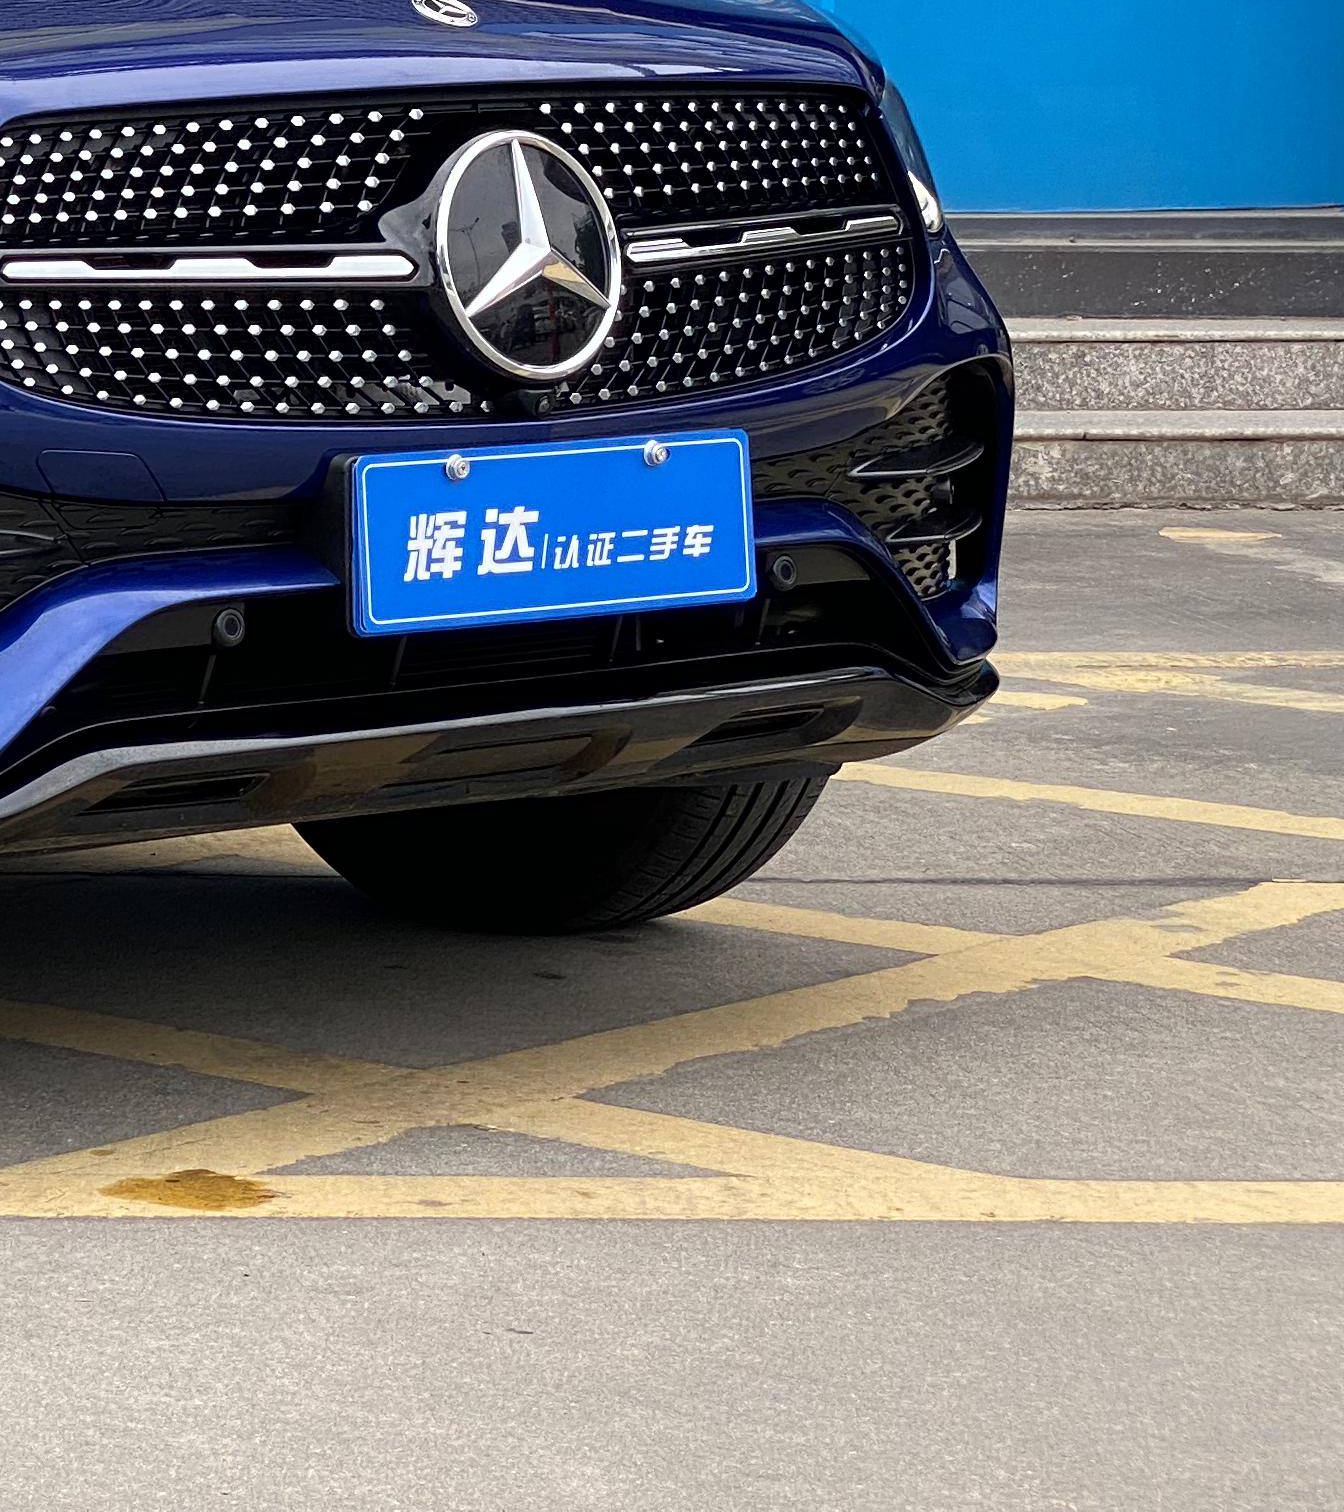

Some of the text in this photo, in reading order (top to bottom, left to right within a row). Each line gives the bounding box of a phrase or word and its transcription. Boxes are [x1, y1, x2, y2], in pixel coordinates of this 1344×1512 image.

[403, 505, 714, 582] 辉达 认证二手车
